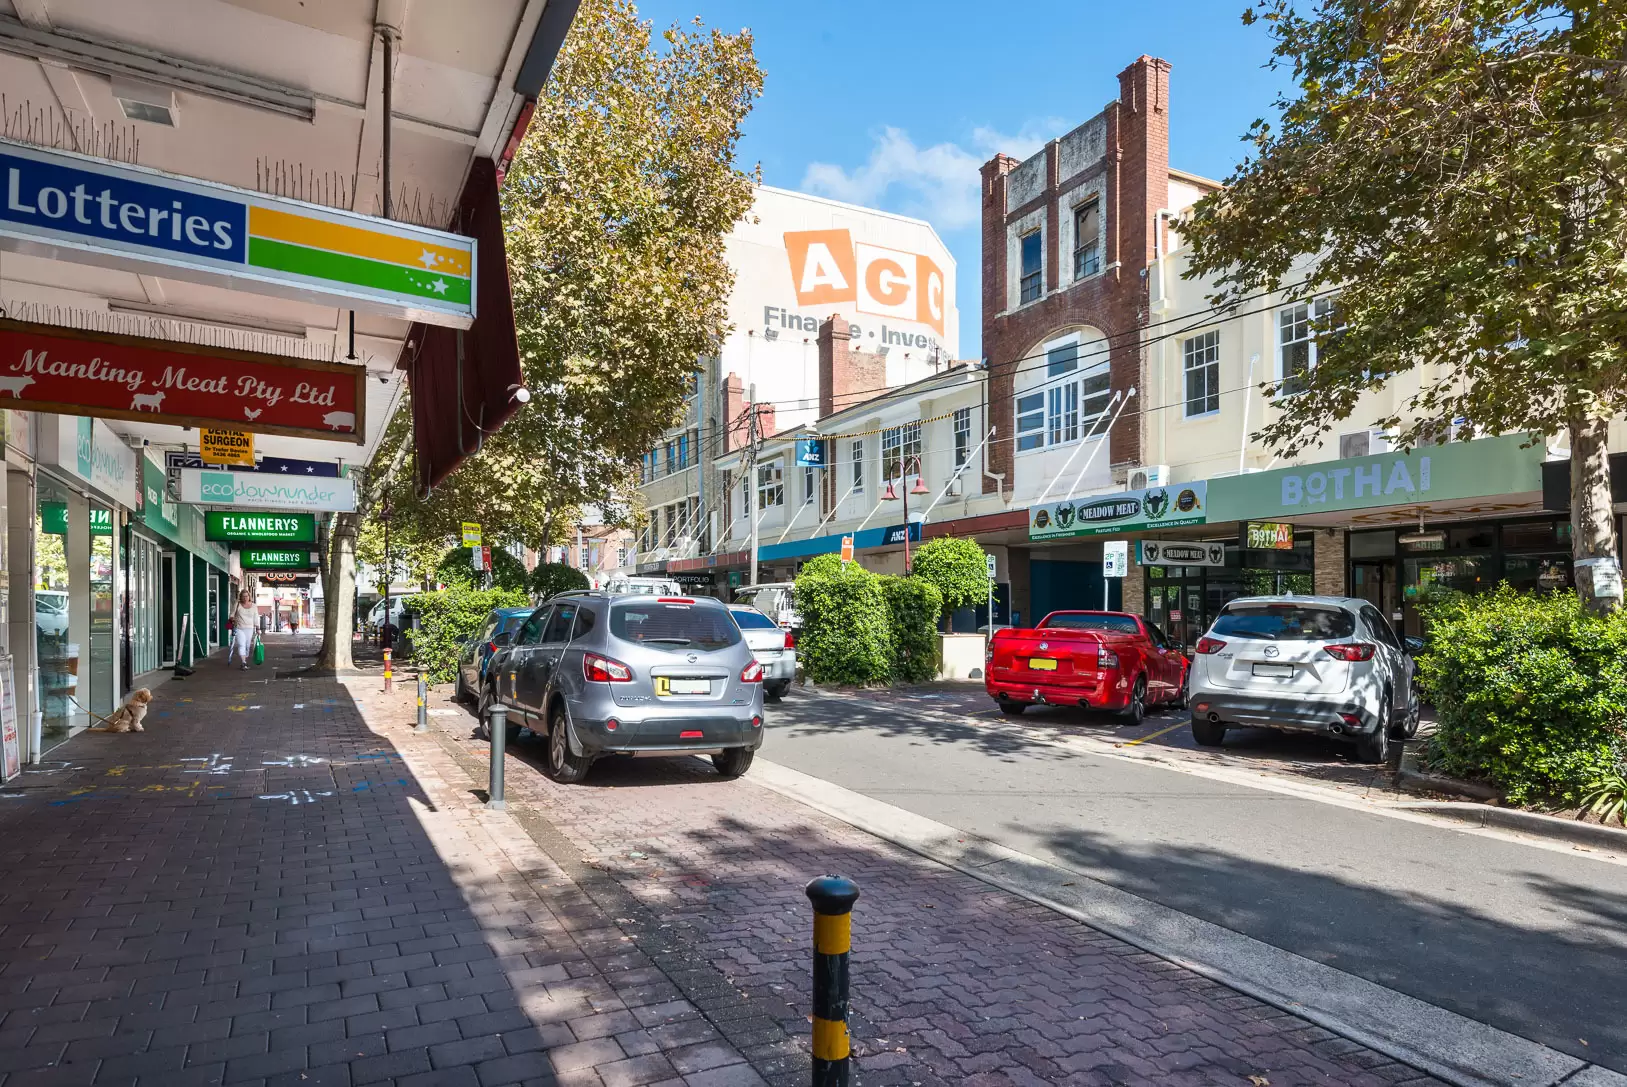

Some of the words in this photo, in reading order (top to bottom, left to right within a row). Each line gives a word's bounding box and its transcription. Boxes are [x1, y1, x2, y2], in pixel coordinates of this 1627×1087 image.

[8, 168, 233, 250] Lotteries
[800, 243, 942, 320] AGC
[764, 306, 862, 340] Finae
[10, 349, 145, 391] Manling
[152, 366, 228, 394] Meat
[234, 376, 284, 407] Pty
[290, 382, 335, 406] Ltd
[203, 434, 249, 447] SURGEON
[802, 453, 820, 461] ANZ
[1281, 456, 1431, 506] BOTHAI
[202, 481, 336, 501] ecodownunder
[1083, 504, 1115, 520] MEADOW
[1116, 502, 1136, 516] MEAT
[222, 517, 299, 531] FLANNERYS
[890, 531, 906, 542] ANZ
[1253, 529, 1288, 542] BOTHAI
[251, 552, 300, 562] FLANNERYS
[1166, 549, 1189, 558] MEADOW
[1190, 550, 1202, 559] MEAT
[673, 575, 710, 584] PORTFOLIO
